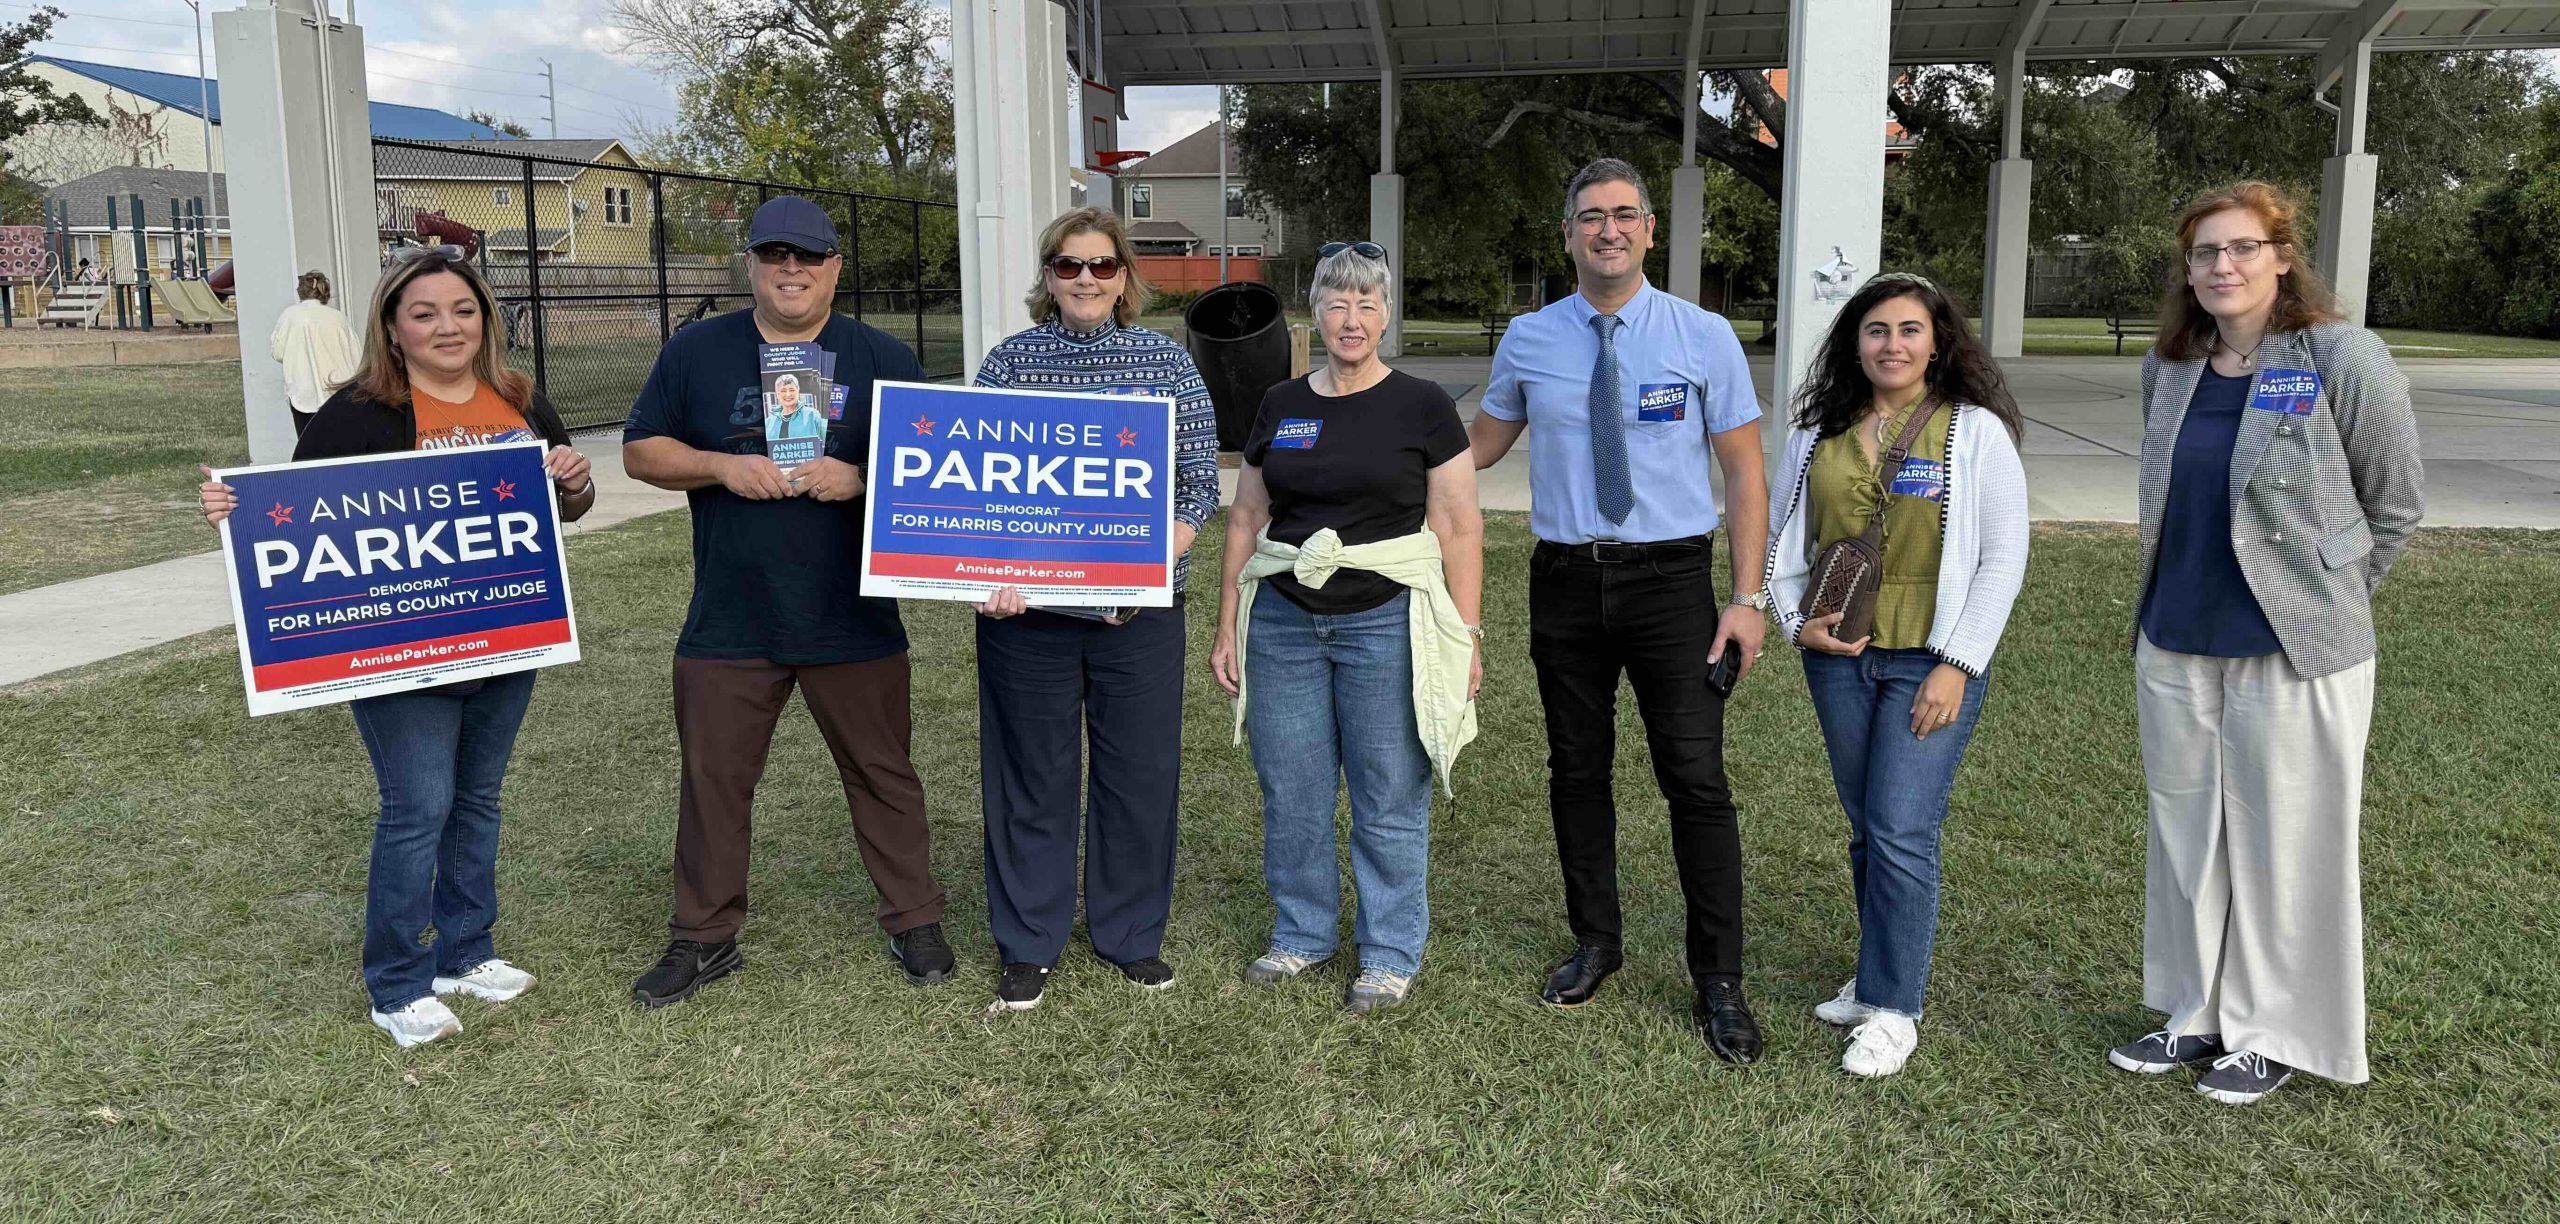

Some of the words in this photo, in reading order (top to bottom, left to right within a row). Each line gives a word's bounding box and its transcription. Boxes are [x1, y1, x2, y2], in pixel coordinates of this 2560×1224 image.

[2260, 382, 2315, 394] PARKER
[2270, 376, 2302, 384] ANNISE
[1641, 391, 1685, 408] PARKER
[1648, 388, 1675, 397] ANNISE
[947, 417, 1103, 447] ANNISE
[1276, 427, 1318, 437] PARKER
[772, 441, 814, 452] ANNISE
[772, 450, 815, 460] PARKER
[892, 446, 1153, 499] PARKER
[1896, 470, 1944, 481] PARKER
[310, 481, 481, 523] ANNISE
[985, 503, 1061, 516] DEMOCRAT
[892, 513, 930, 528] FOR
[934, 516, 1003, 532] HARRIS
[1007, 520, 1086, 535] COUNTY
[1088, 523, 1151, 537] JUDGE
[253, 511, 543, 589] PARKER
[955, 562, 1085, 579] AnniseParker.com
[369, 577, 450, 598] DEMOCRAT
[268, 614, 311, 633] FOR
[316, 602, 393, 626] HARRIS
[397, 589, 480, 614] COUNTY
[484, 580, 548, 601] JUDGE
[350, 638, 489, 670] AnniseParker.com
